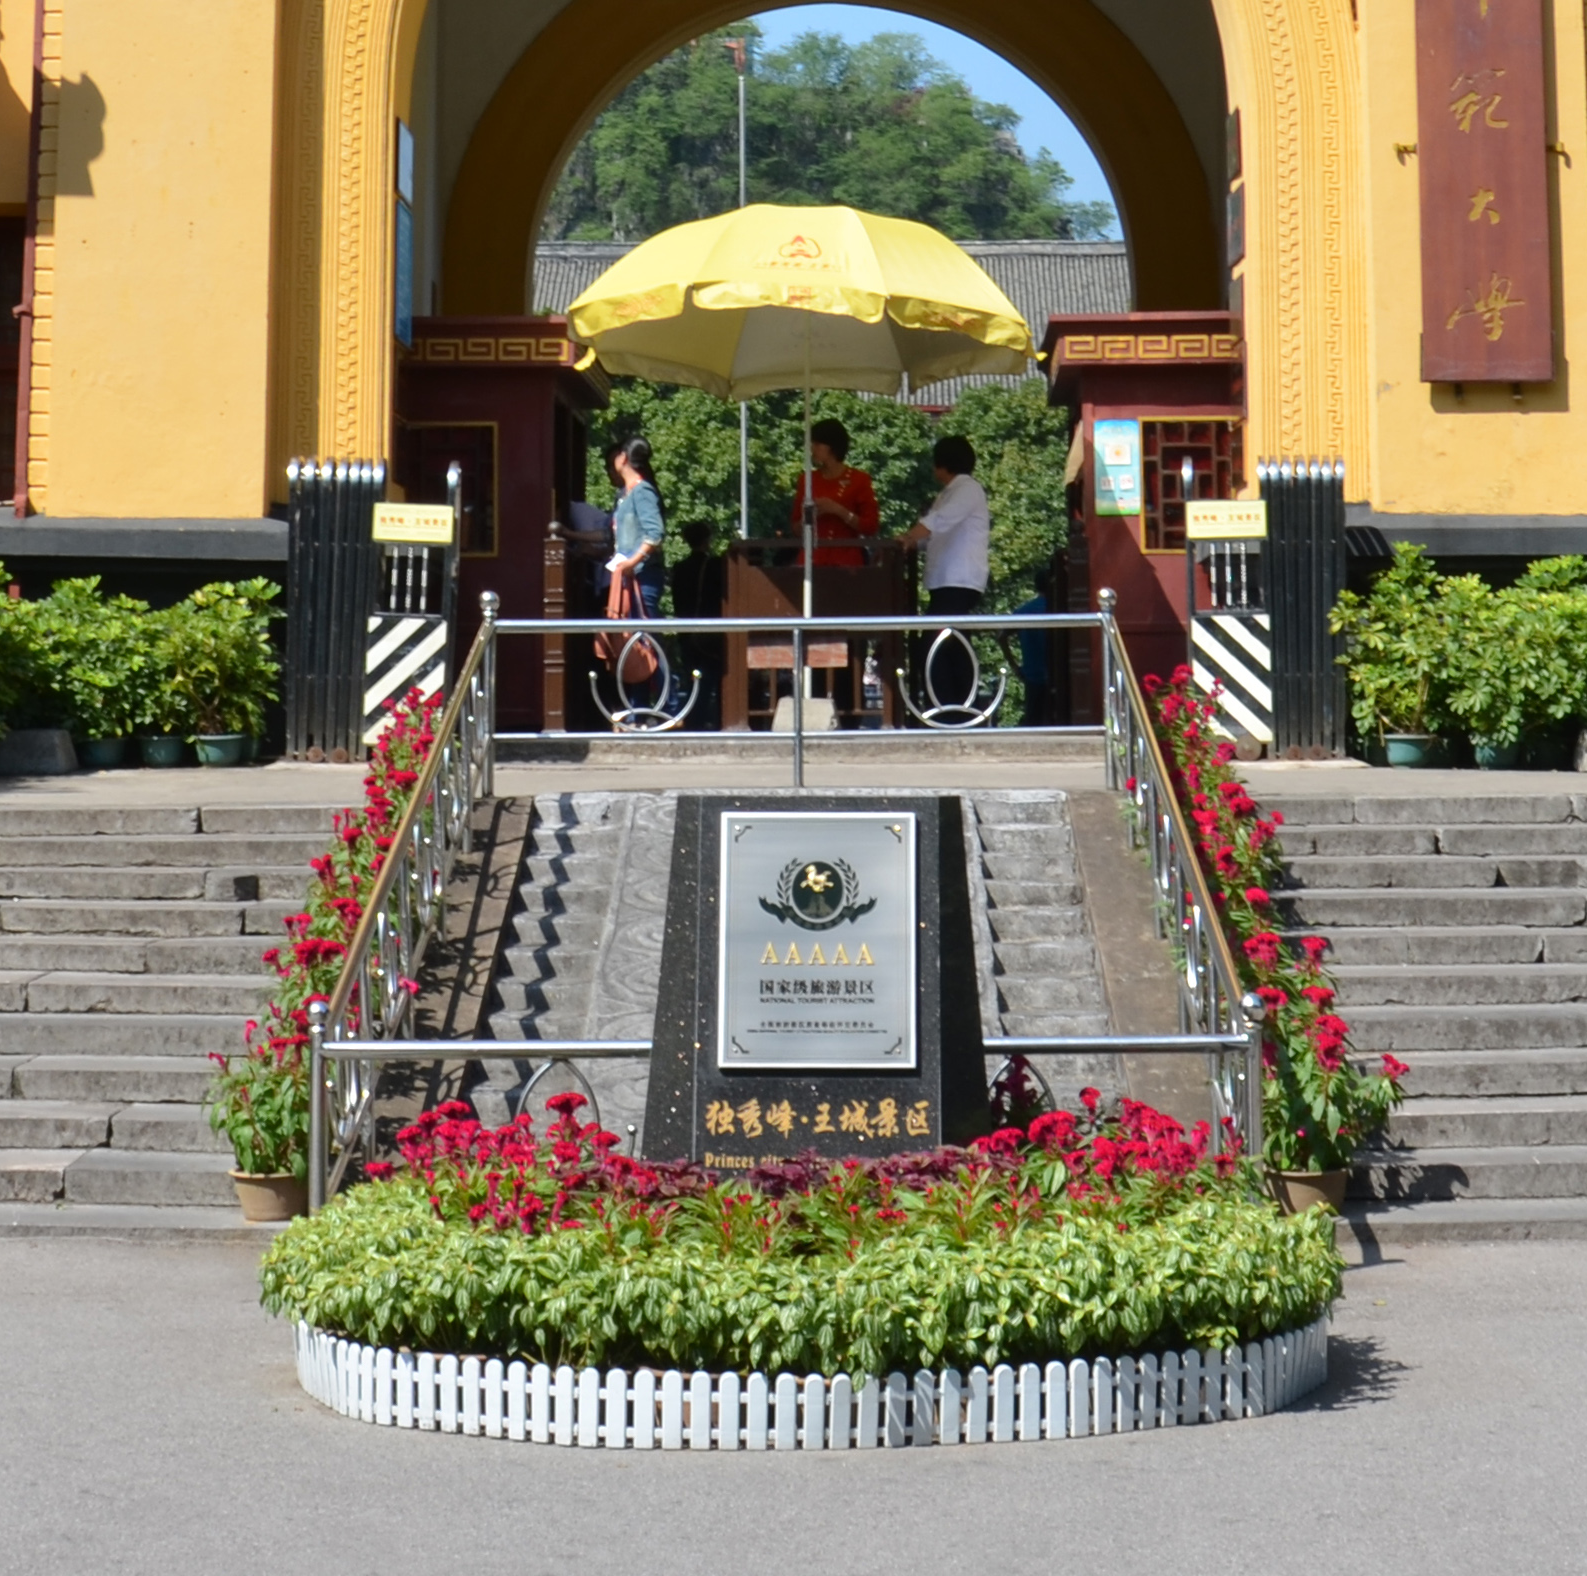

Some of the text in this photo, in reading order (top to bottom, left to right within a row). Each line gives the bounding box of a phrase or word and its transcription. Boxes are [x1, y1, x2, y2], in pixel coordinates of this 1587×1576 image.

[760, 979, 874, 995] 国家级旅游景区
[705, 1097, 931, 1139] 独秀峰·王城景区
[704, 1152, 755, 1168] Princes
